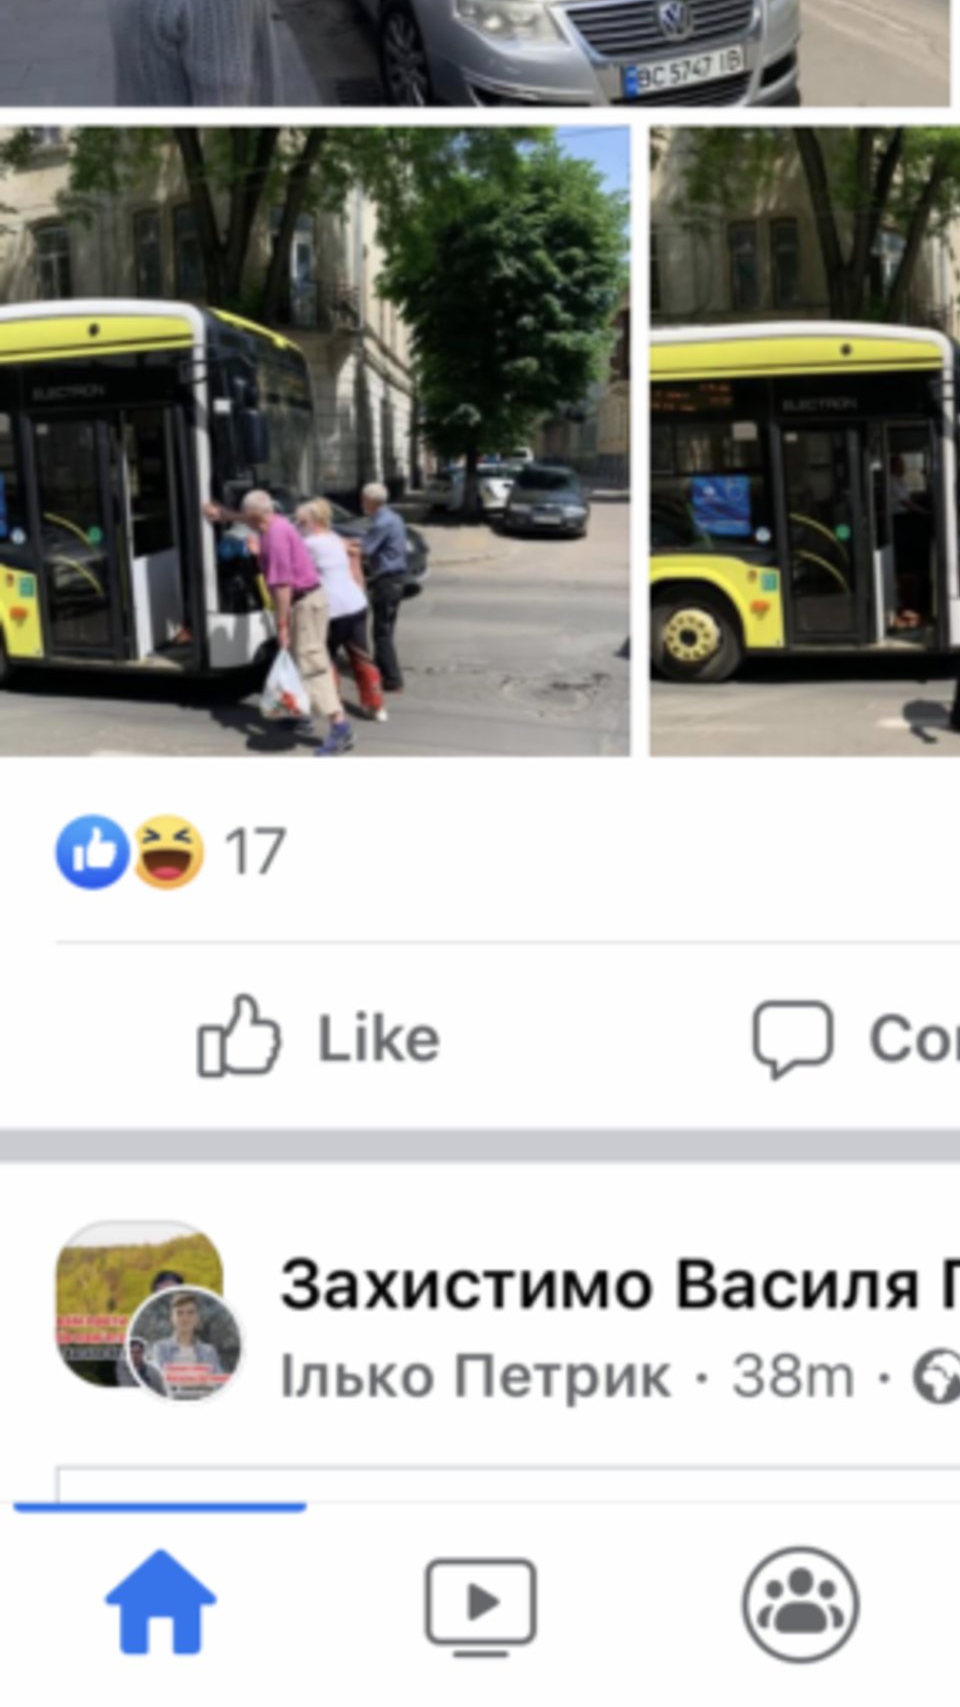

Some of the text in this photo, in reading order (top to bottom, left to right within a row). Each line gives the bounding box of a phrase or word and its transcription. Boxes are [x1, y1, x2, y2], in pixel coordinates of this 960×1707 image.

[226, 827, 287, 875] 17
[319, 1011, 440, 1063] Like
[281, 1257, 654, 1312] Захистимо
[676, 1257, 919, 1311] Василя
[282, 1353, 671, 1408] Ілько Петрик
[733, 1353, 853, 1398] 38m
